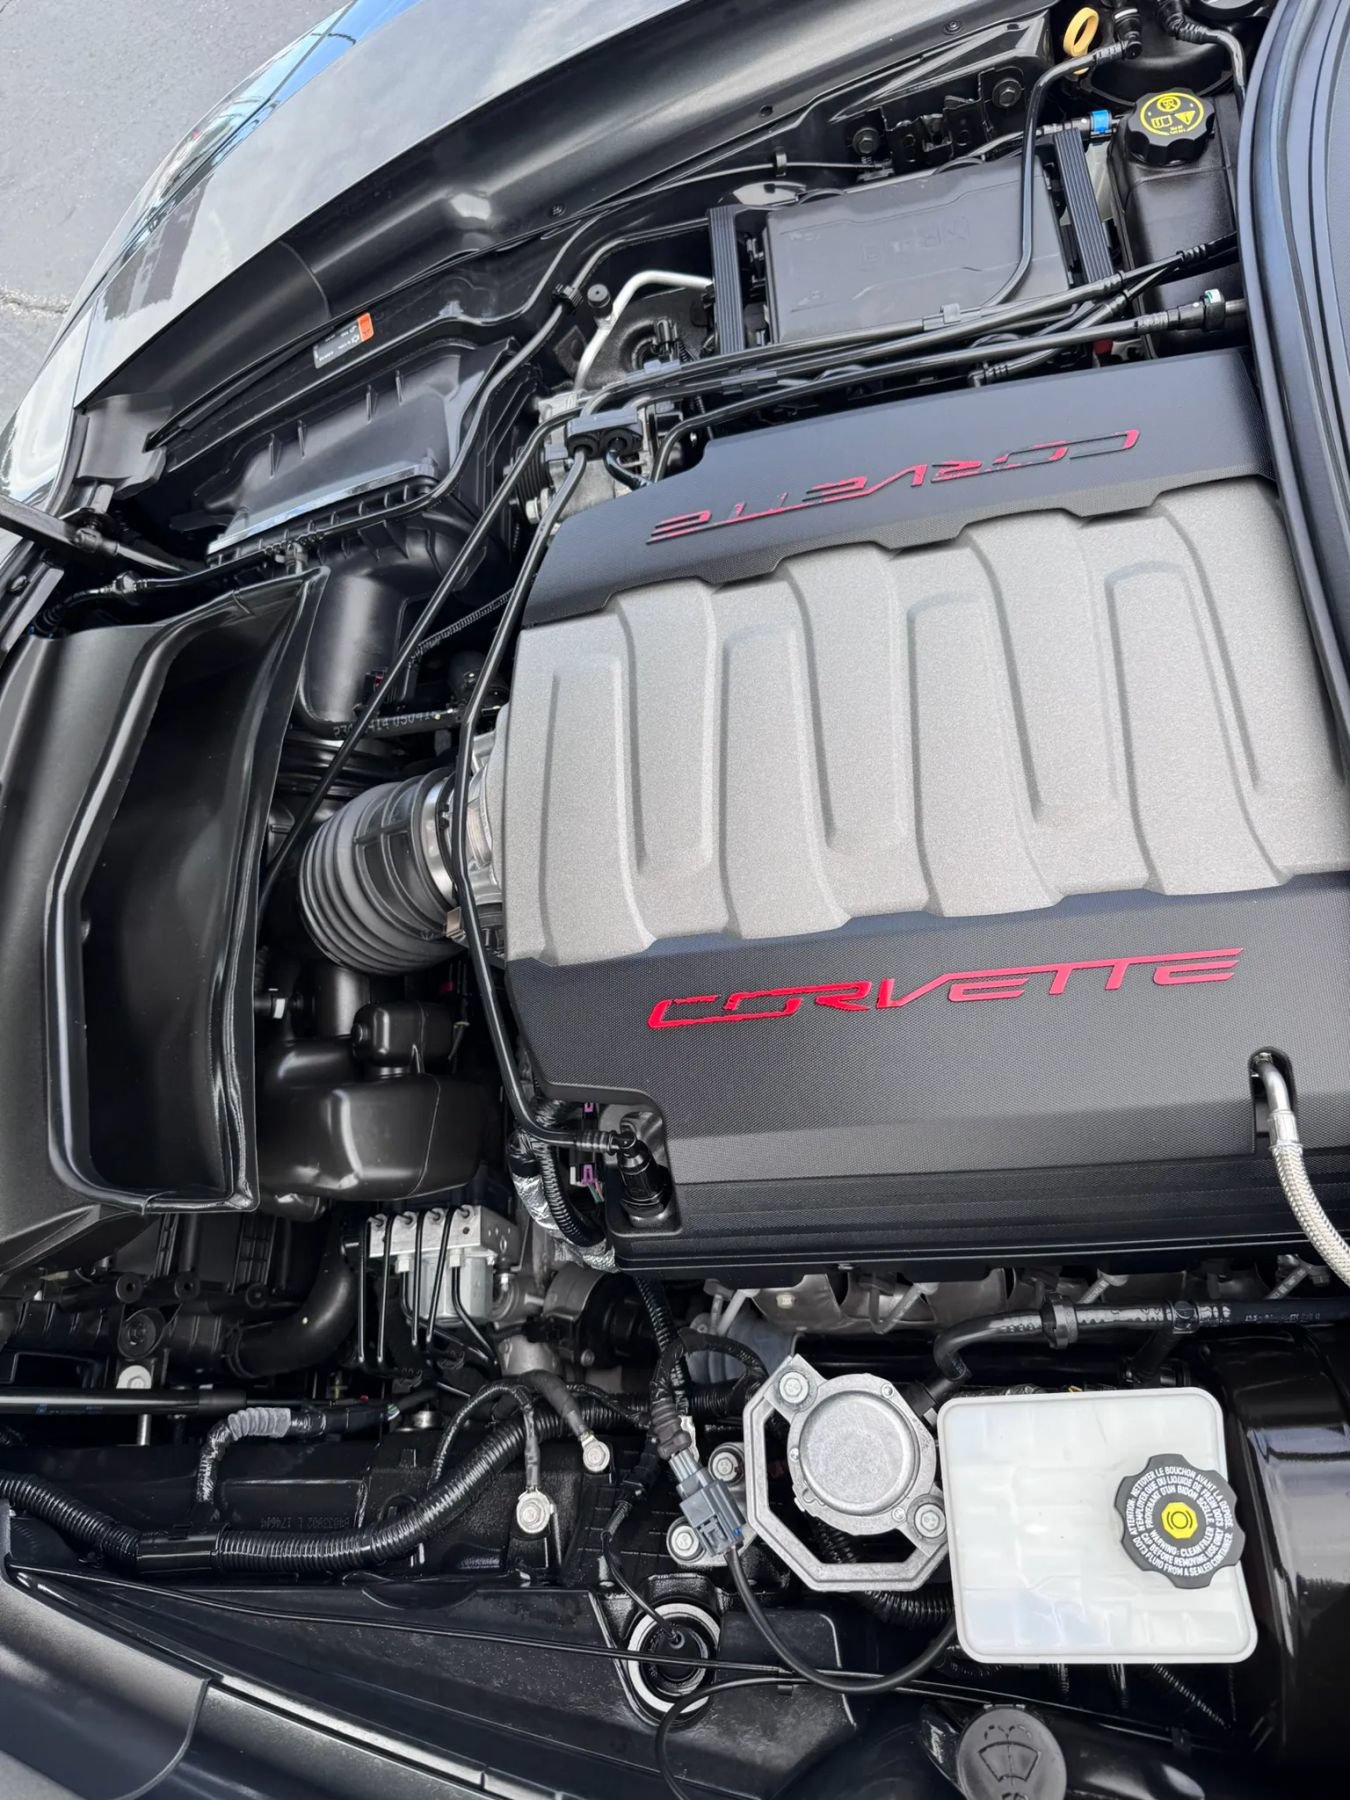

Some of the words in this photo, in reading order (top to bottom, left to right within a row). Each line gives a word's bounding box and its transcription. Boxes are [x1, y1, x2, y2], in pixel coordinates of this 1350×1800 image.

[646, 428, 1140, 545] CORVETTE
[647, 946, 1245, 1029] CORVETTE
[1130, 1470, 1156, 1497] NETTOYER
[1155, 1467, 1165, 1476] LE
[1165, 1466, 1196, 1478] BOUCHON
[1196, 1474, 1216, 1492] AVANT
[1213, 1490, 1224, 1501] LA
[1145, 1481, 1158, 1494] QUE
[1156, 1477, 1166, 1485] DU
[1167, 1475, 1193, 1487] LIQUIDE
[1192, 1482, 1202, 1492] DE
[1201, 1488, 1218, 1509] FREIN
[1213, 1508, 1224, 1527] DOT3
[1145, 1491, 1161, 1528] PROVENANT
[1177, 1485, 1199, 1500] BIDON
[1133, 1536, 1148, 1555] DOT3
[1145, 1551, 1164, 1569] FLUID
[1164, 1563, 1184, 1576] FROM
[1190, 1562, 1213, 1576] SEALED
[1141, 1532, 1153, 1545] CAP
[1149, 1544, 1173, 1564] BEFORE
[1205, 1543, 1219, 1558] USE
[1213, 1527, 1224, 1546] ONLY
[1180, 1544, 1202, 1557] CLEAN
[1199, 1526, 1214, 1550] FILLER
